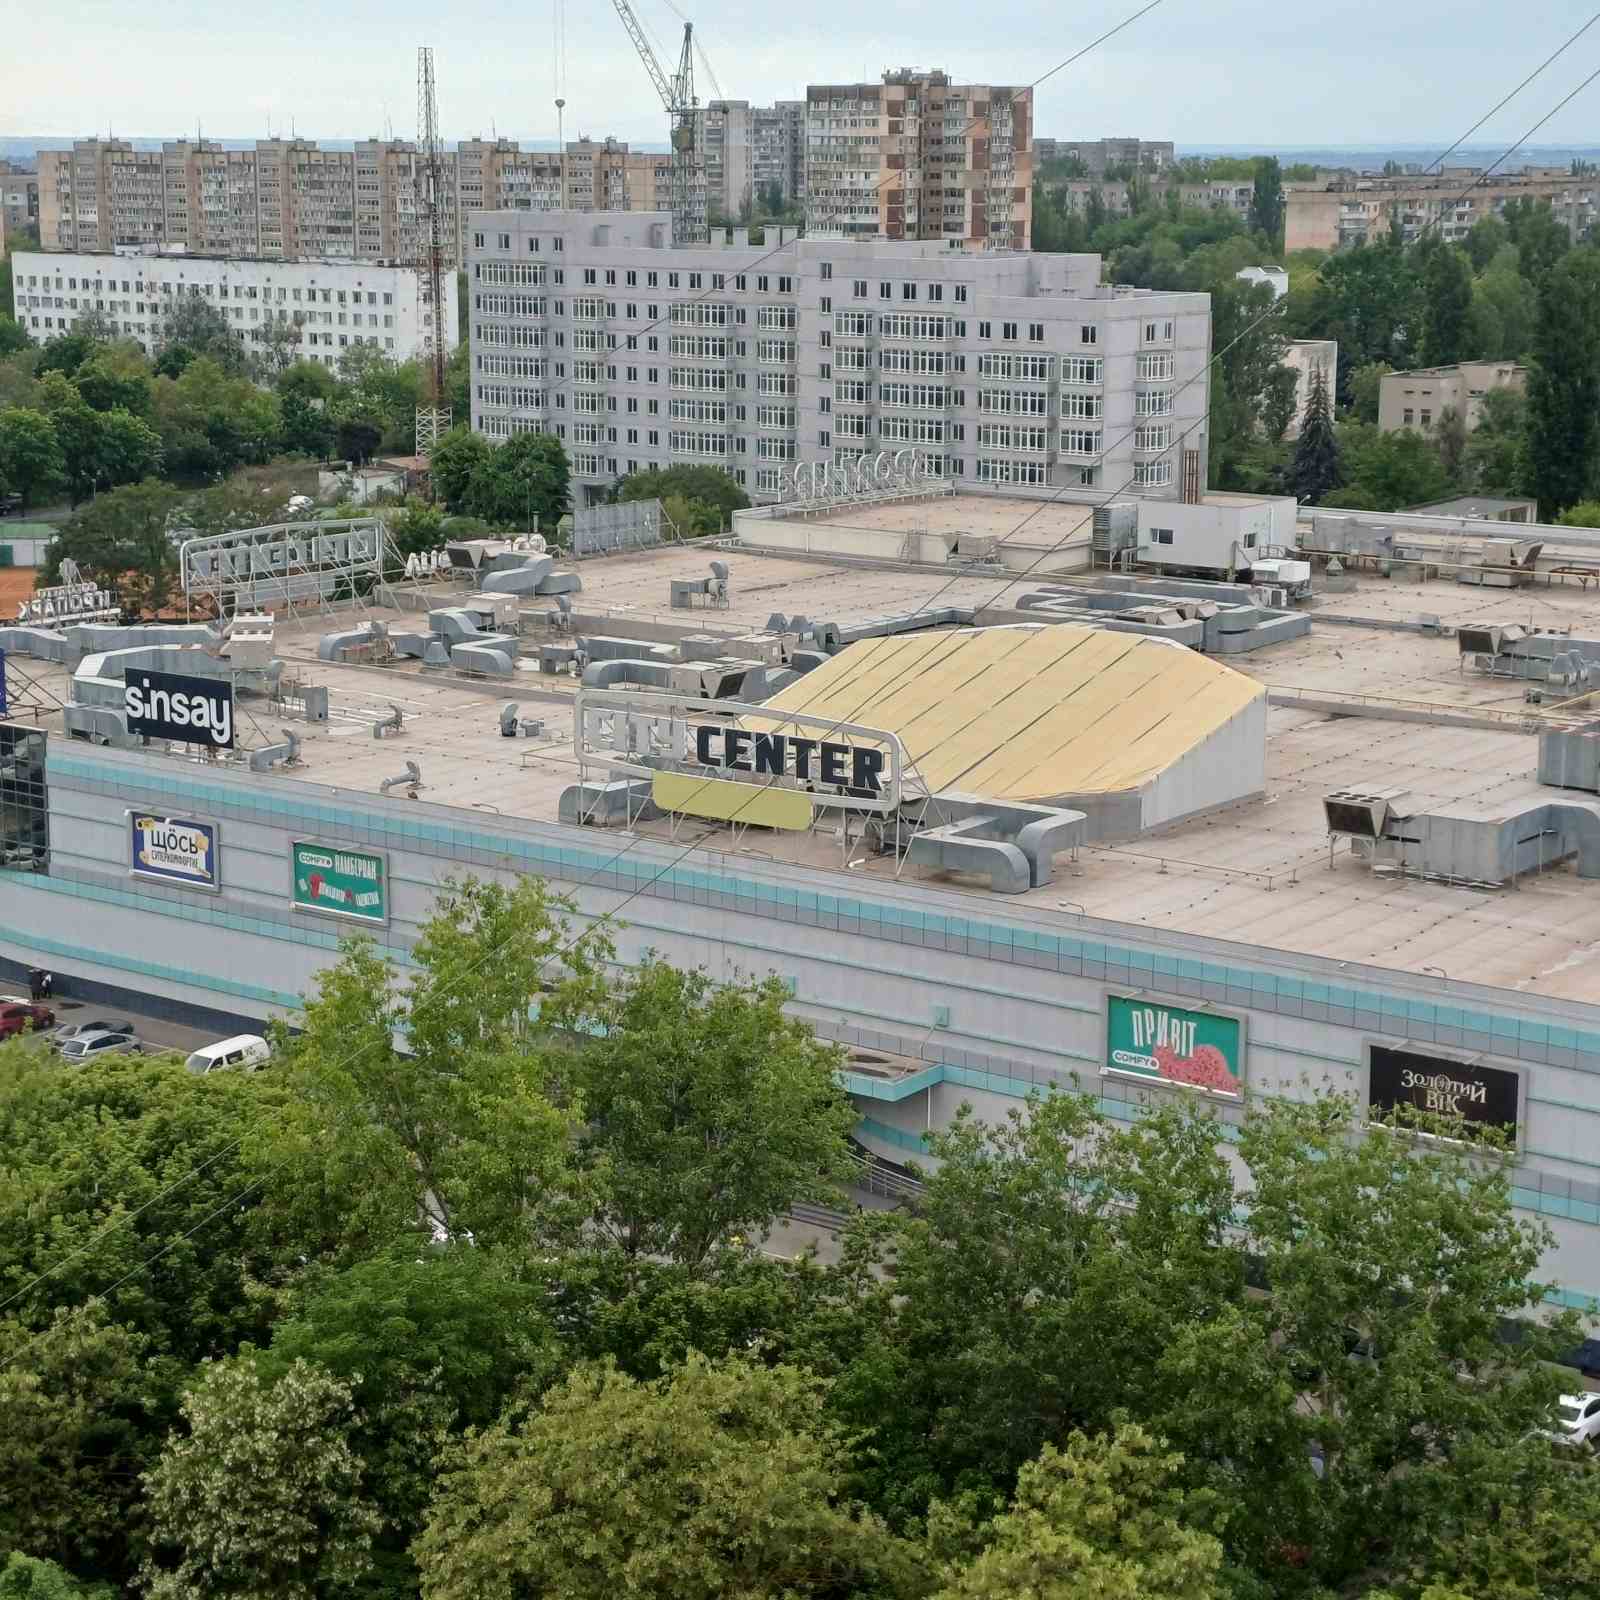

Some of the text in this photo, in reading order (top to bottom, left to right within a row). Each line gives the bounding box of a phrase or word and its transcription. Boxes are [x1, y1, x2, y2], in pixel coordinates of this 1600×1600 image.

[125, 678, 231, 744] sinsay
[697, 725, 883, 791] CENTER
[1114, 1052, 1150, 1067] COMFY
[1132, 1008, 1197, 1058] ПРИВІТ
